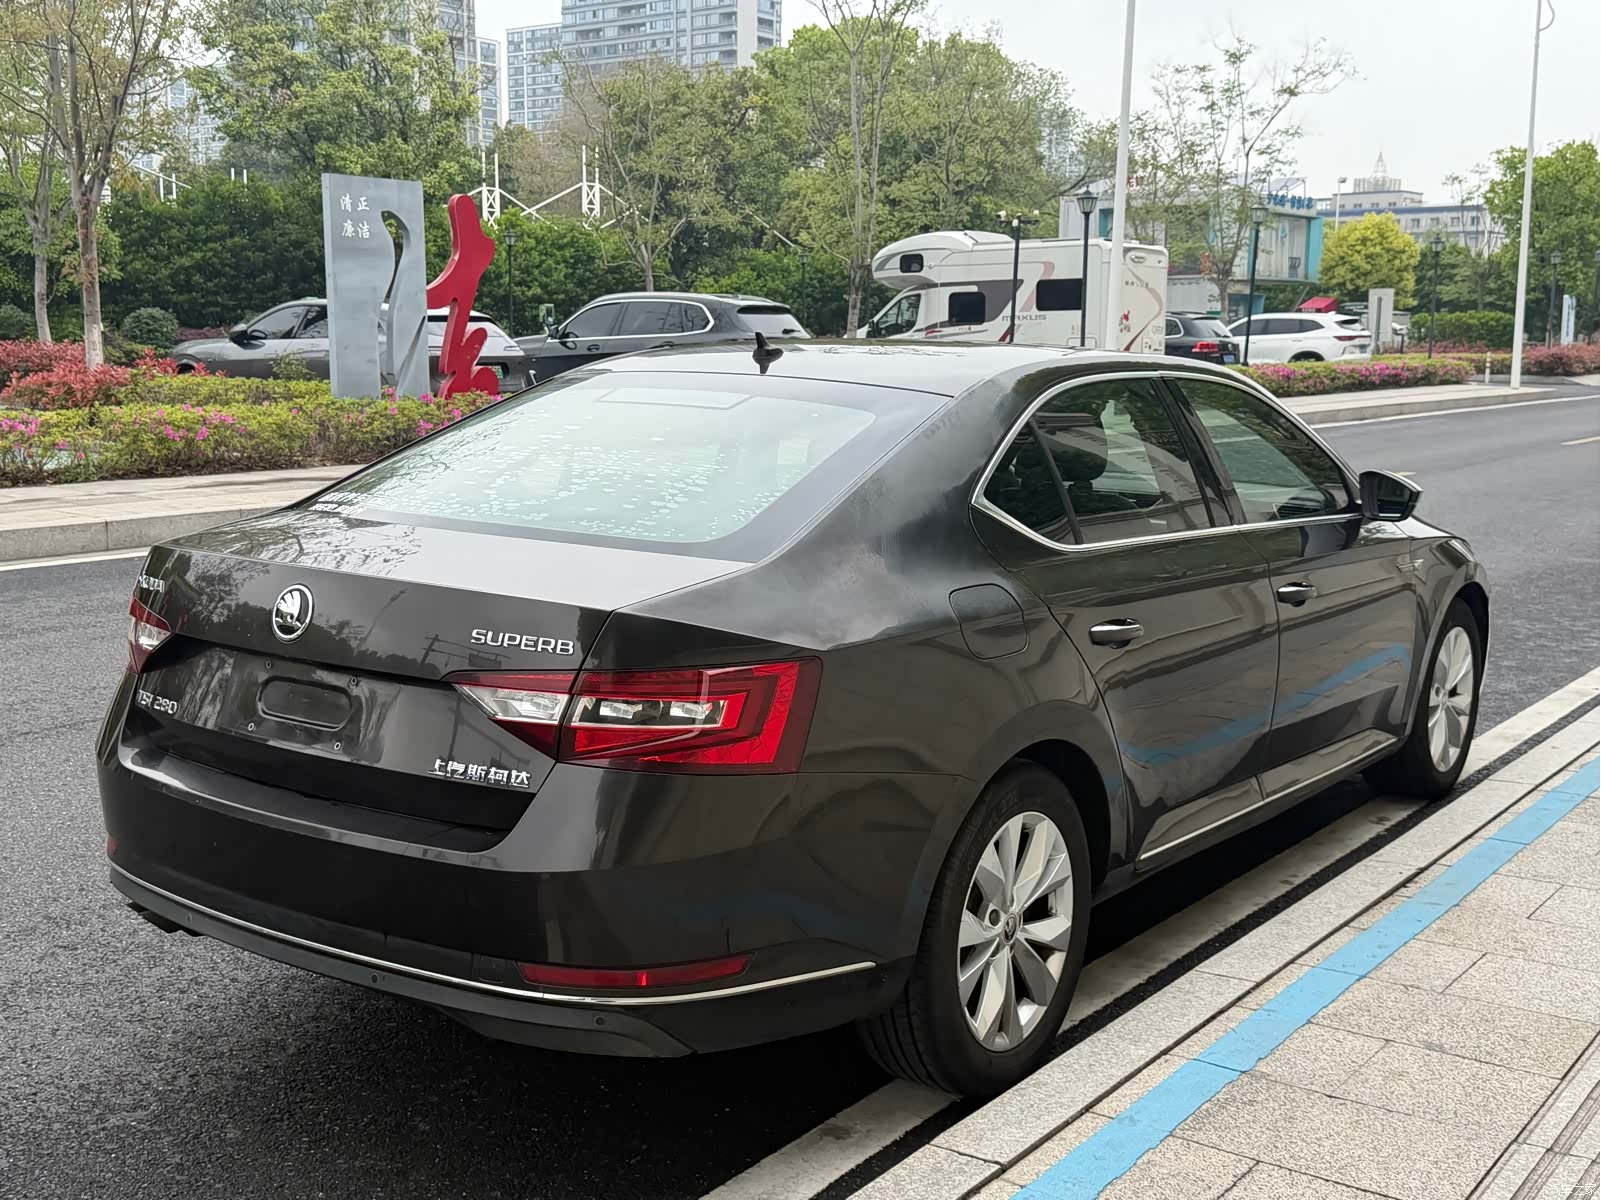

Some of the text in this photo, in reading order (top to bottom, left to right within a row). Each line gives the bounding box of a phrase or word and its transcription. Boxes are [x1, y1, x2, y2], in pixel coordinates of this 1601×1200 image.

[470, 628, 575, 655] SUPERB
[153, 695, 178, 714] 280
[427, 758, 531, 788] 上汽斯柯达
